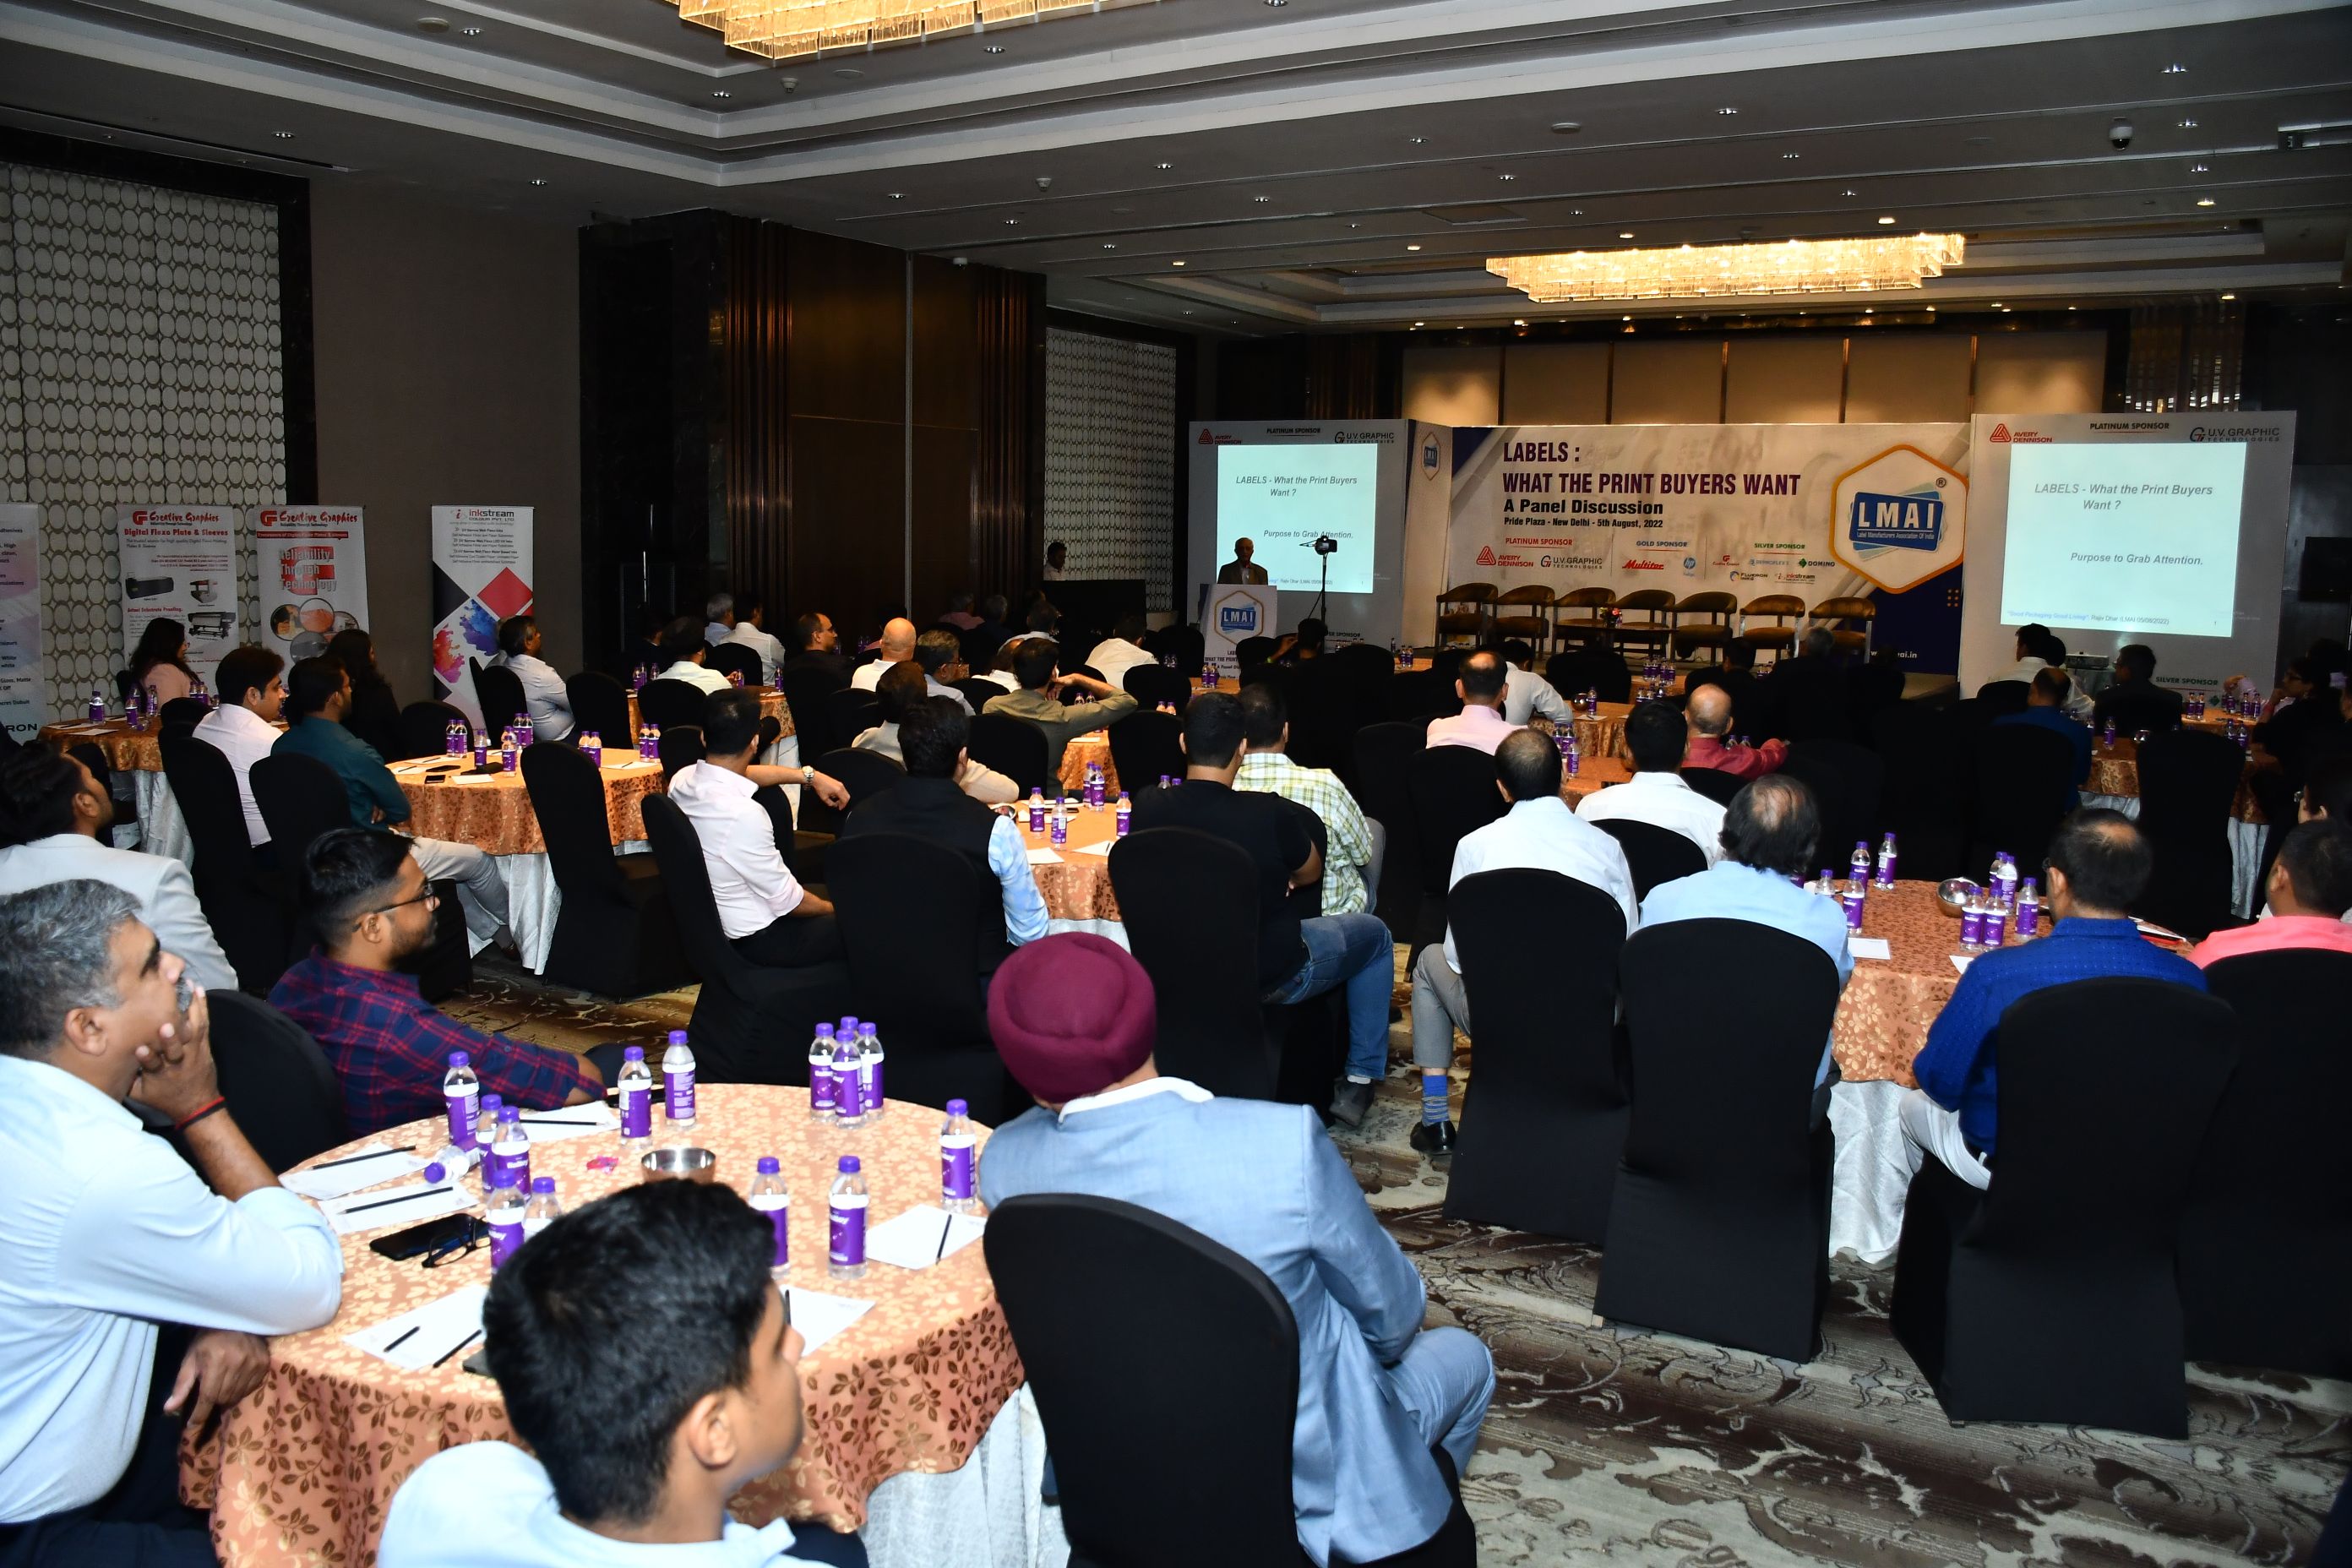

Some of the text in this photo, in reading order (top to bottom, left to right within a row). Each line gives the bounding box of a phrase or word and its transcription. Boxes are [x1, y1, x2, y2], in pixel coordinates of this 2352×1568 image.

[1346, 432, 1358, 440] U.V.
[2208, 427, 2279, 437] U.V. GRAPHIC
[1503, 441, 1580, 463] LABELS :
[1236, 476, 1267, 485] LABELS
[1274, 476, 1294, 485] What
[1295, 476, 1308, 485] the
[1309, 476, 1328, 485] Print
[1330, 476, 1358, 487] Buyers
[1502, 472, 1801, 496] WHAT THE PRINT BUYERS WANT
[1270, 488, 1297, 497] Want ?
[2034, 483, 2080, 494] LABELS
[2089, 484, 2118, 495] What
[2121, 484, 2138, 495] the
[2141, 484, 2170, 495] Print
[2171, 485, 2213, 497] Buyers
[1503, 498, 1663, 514] A Panel Discussion
[2082, 500, 2121, 510] Want ?
[150, 511, 220, 524] Creative Graphics
[280, 510, 358, 525] Creative Graphics
[469, 509, 514, 517] inkstream
[1858, 502, 1935, 529] LMAI
[1504, 517, 1523, 526] Pride
[1525, 518, 1546, 526] Plaza
[1552, 518, 1568, 526] New
[1571, 518, 1590, 527] Delhi
[1597, 519, 1610, 527] 5th
[1612, 520, 1642, 529] August,
[1643, 520, 1663, 528] 2022
[124, 528, 149, 536] Digital
[150, 528, 171, 536] Flexo
[1263, 530, 1292, 539] Purpose
[1505, 537, 1573, 547] PLATINUM SPONSOR
[280, 547, 330, 563] Reliability
[1566, 557, 1603, 565] GRAPHIC
[2070, 553, 2204, 565] Purpose to Grab Attention.
[280, 563, 320, 575] Through
[280, 578, 337, 592] Technology
[1223, 611, 1254, 623] LMAI
[2181, 677, 2219, 686] SPONSOR
